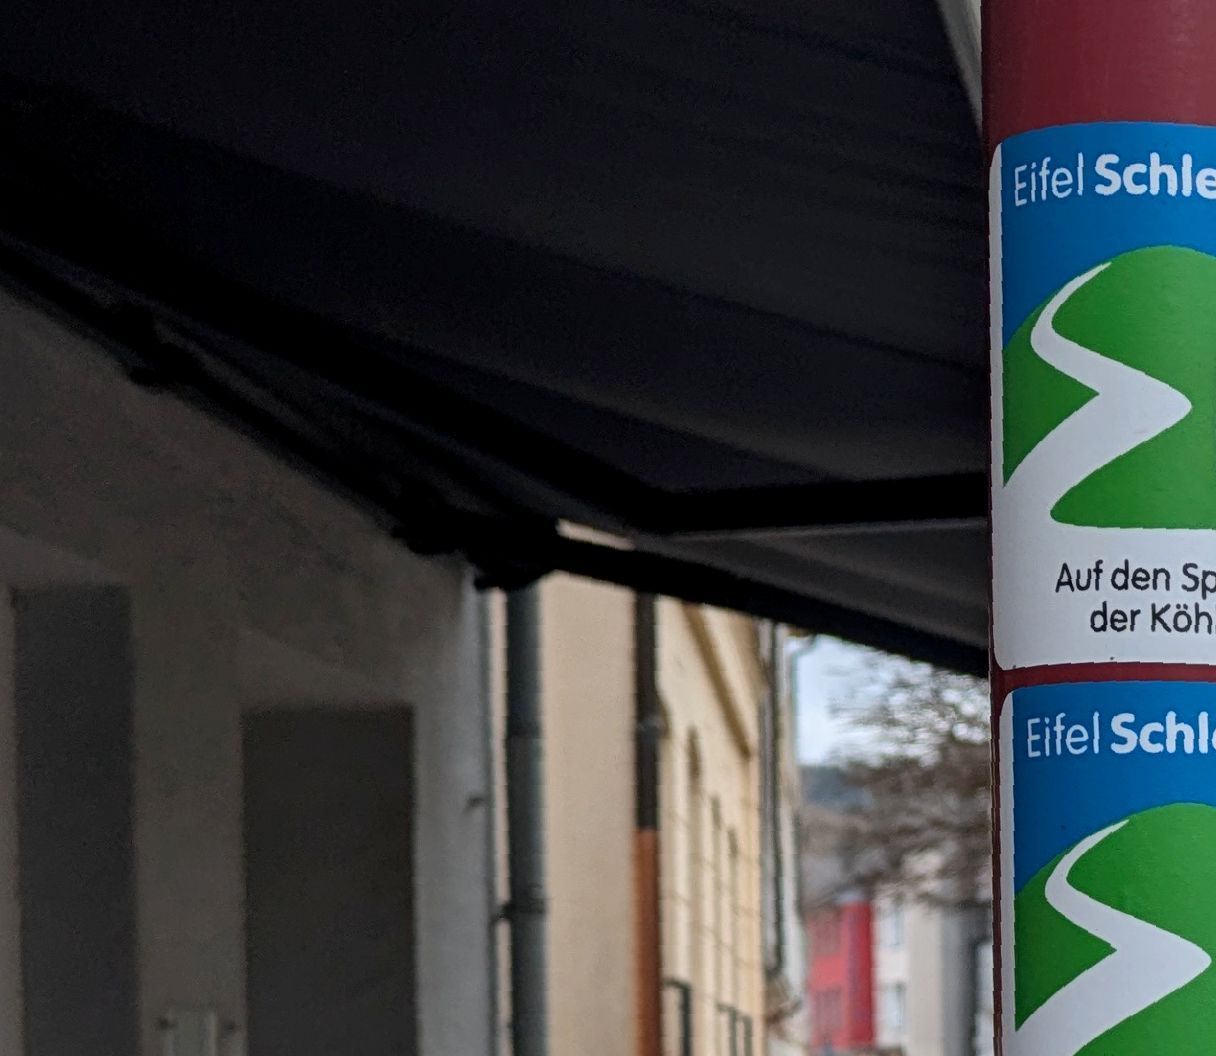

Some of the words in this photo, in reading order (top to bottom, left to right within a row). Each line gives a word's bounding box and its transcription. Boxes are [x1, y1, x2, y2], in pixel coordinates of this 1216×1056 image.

[1015, 153, 1084, 206] Eifel
[1055, 559, 1104, 594] Auf
[1110, 559, 1171, 592] den
[1089, 602, 1141, 634] der
[1027, 712, 1100, 758] Eifel
